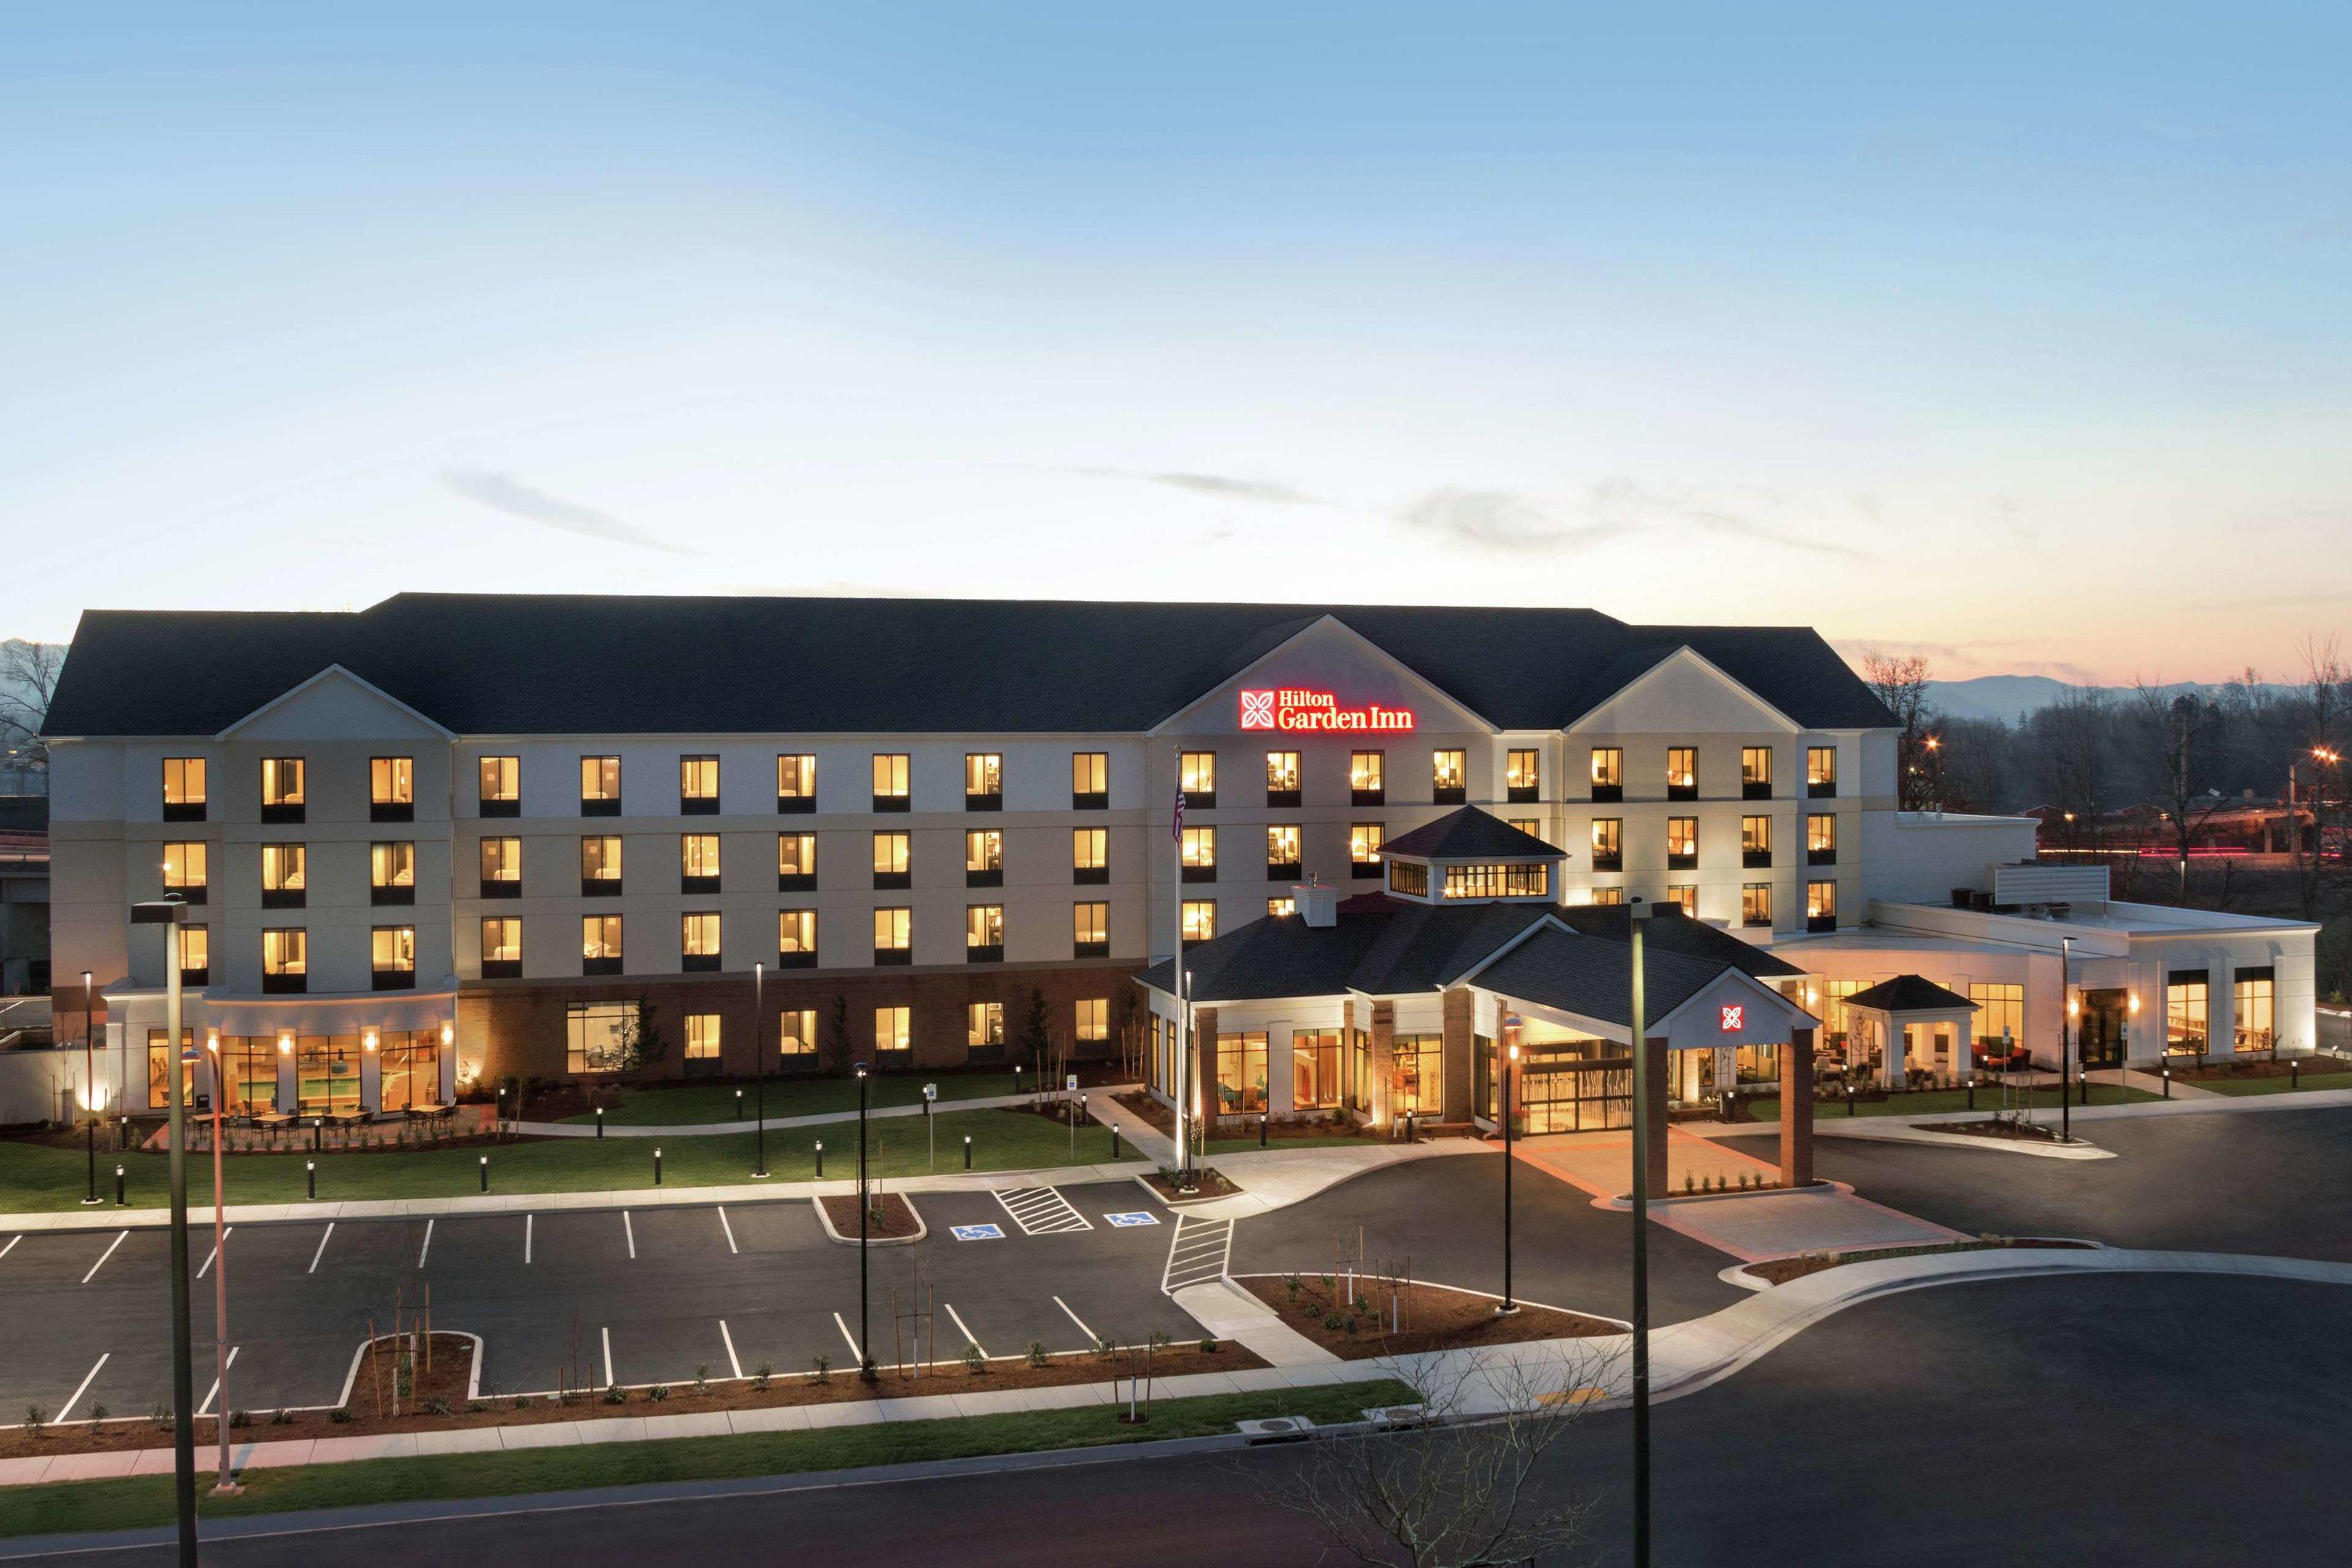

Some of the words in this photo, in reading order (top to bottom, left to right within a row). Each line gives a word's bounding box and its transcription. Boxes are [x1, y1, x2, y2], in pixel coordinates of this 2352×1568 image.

[1278, 690, 1334, 707] Hilton
[1278, 707, 1367, 730] Garden
[1369, 706, 1413, 729] Inn
